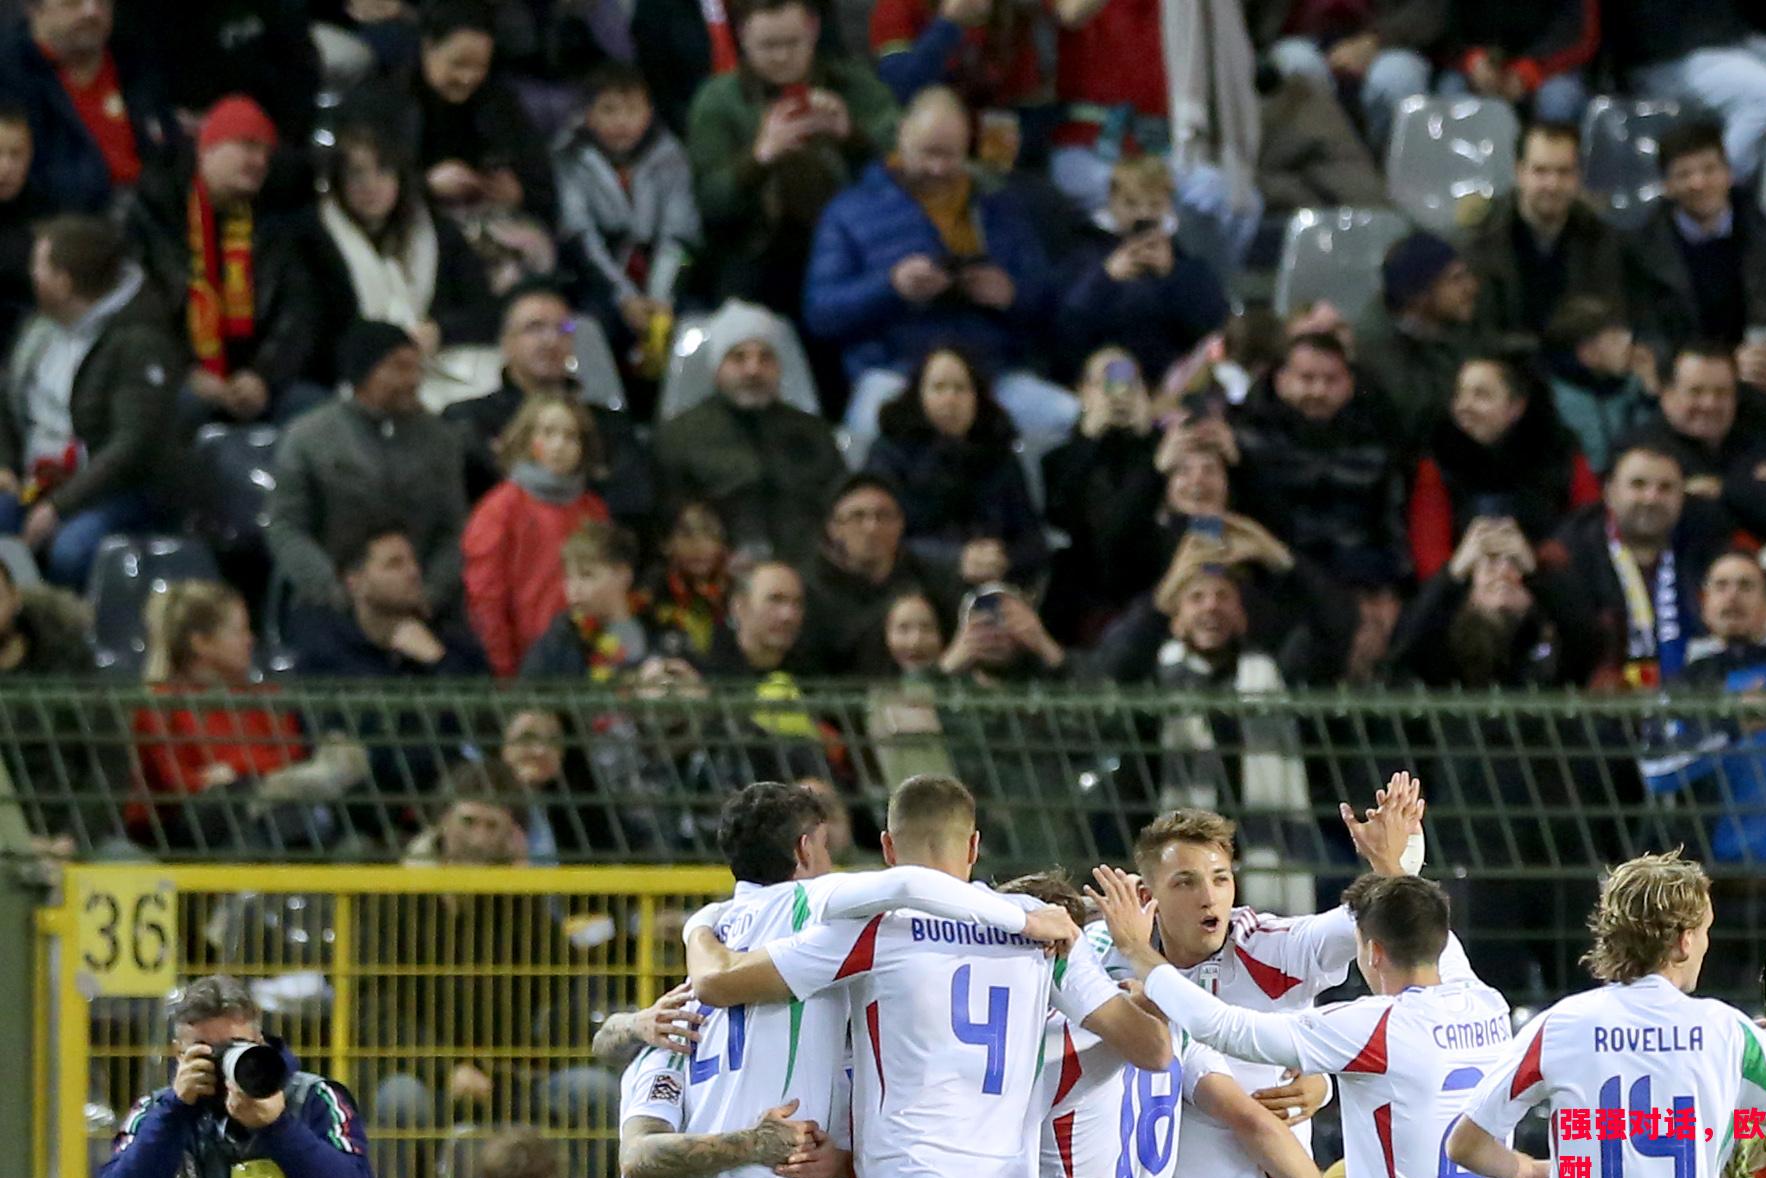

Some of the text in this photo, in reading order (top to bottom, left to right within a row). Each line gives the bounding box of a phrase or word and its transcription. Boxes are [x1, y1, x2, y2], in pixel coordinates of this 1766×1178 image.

[84, 893, 168, 972] 36
[951, 962, 1010, 1096] 4
[1595, 1026, 1703, 1052] ROVELLA
